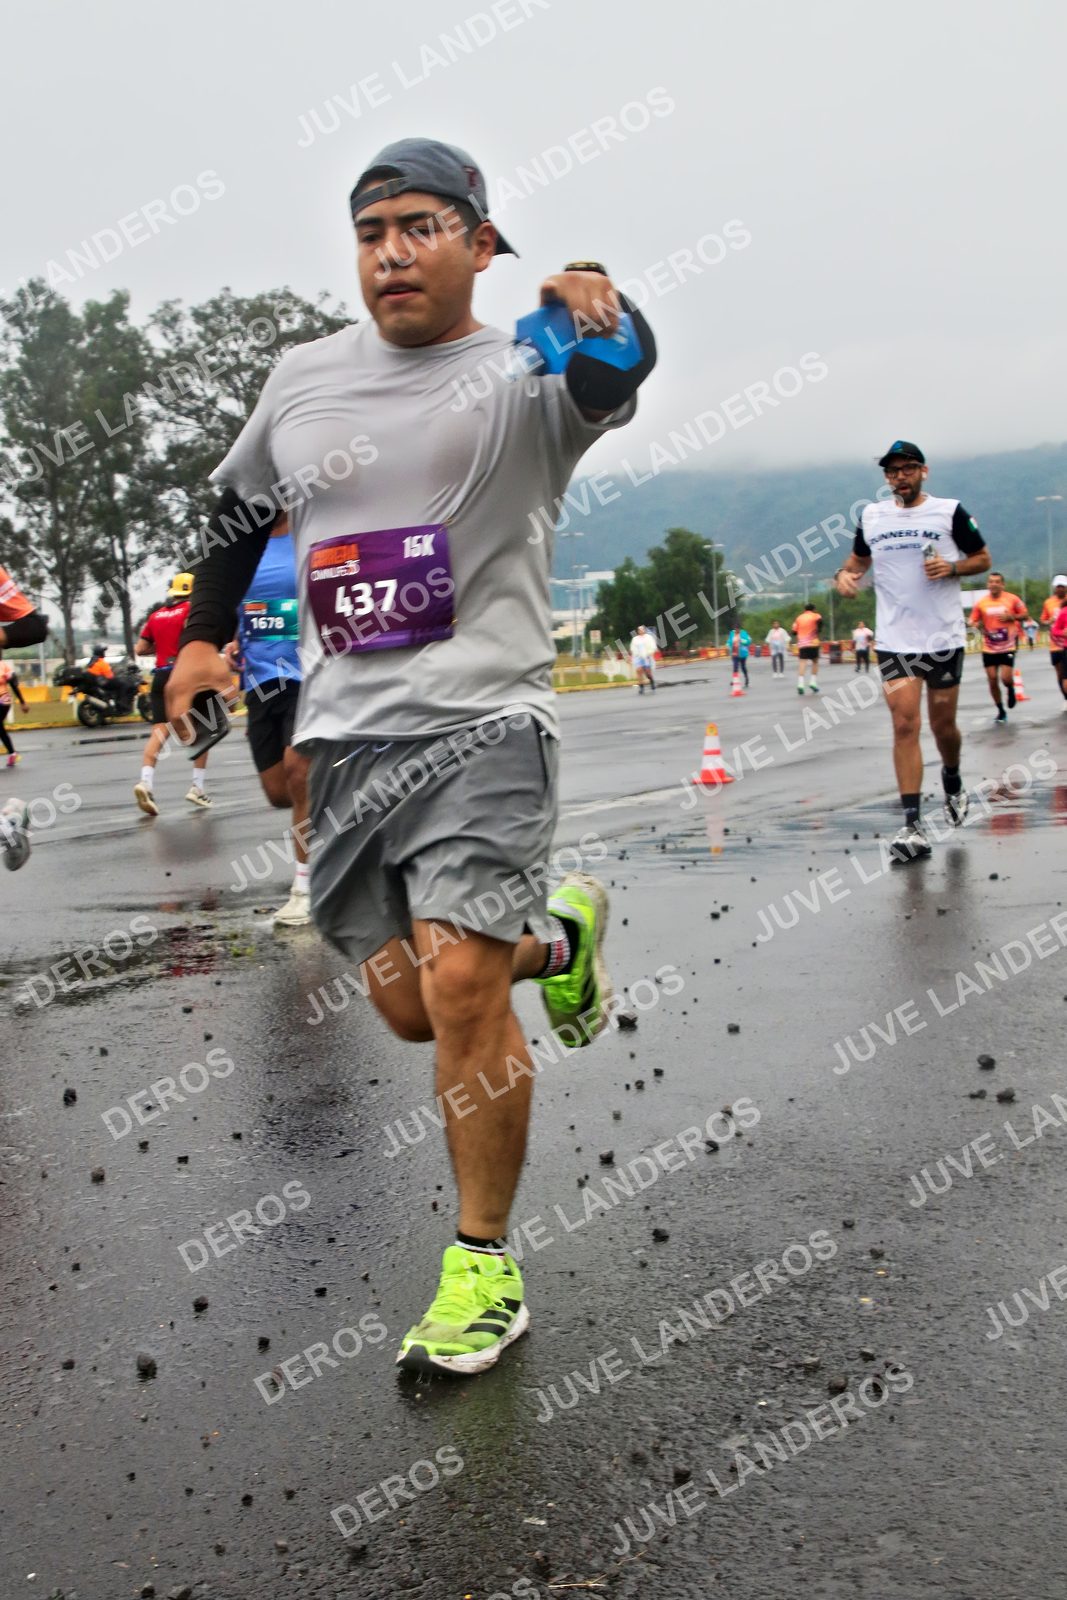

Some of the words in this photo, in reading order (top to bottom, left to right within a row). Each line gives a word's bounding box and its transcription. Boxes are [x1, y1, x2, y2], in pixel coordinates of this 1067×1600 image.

[402, 533, 436, 559] 15K
[334, 578, 398, 618] 437
[250, 616, 285, 629] 1678
